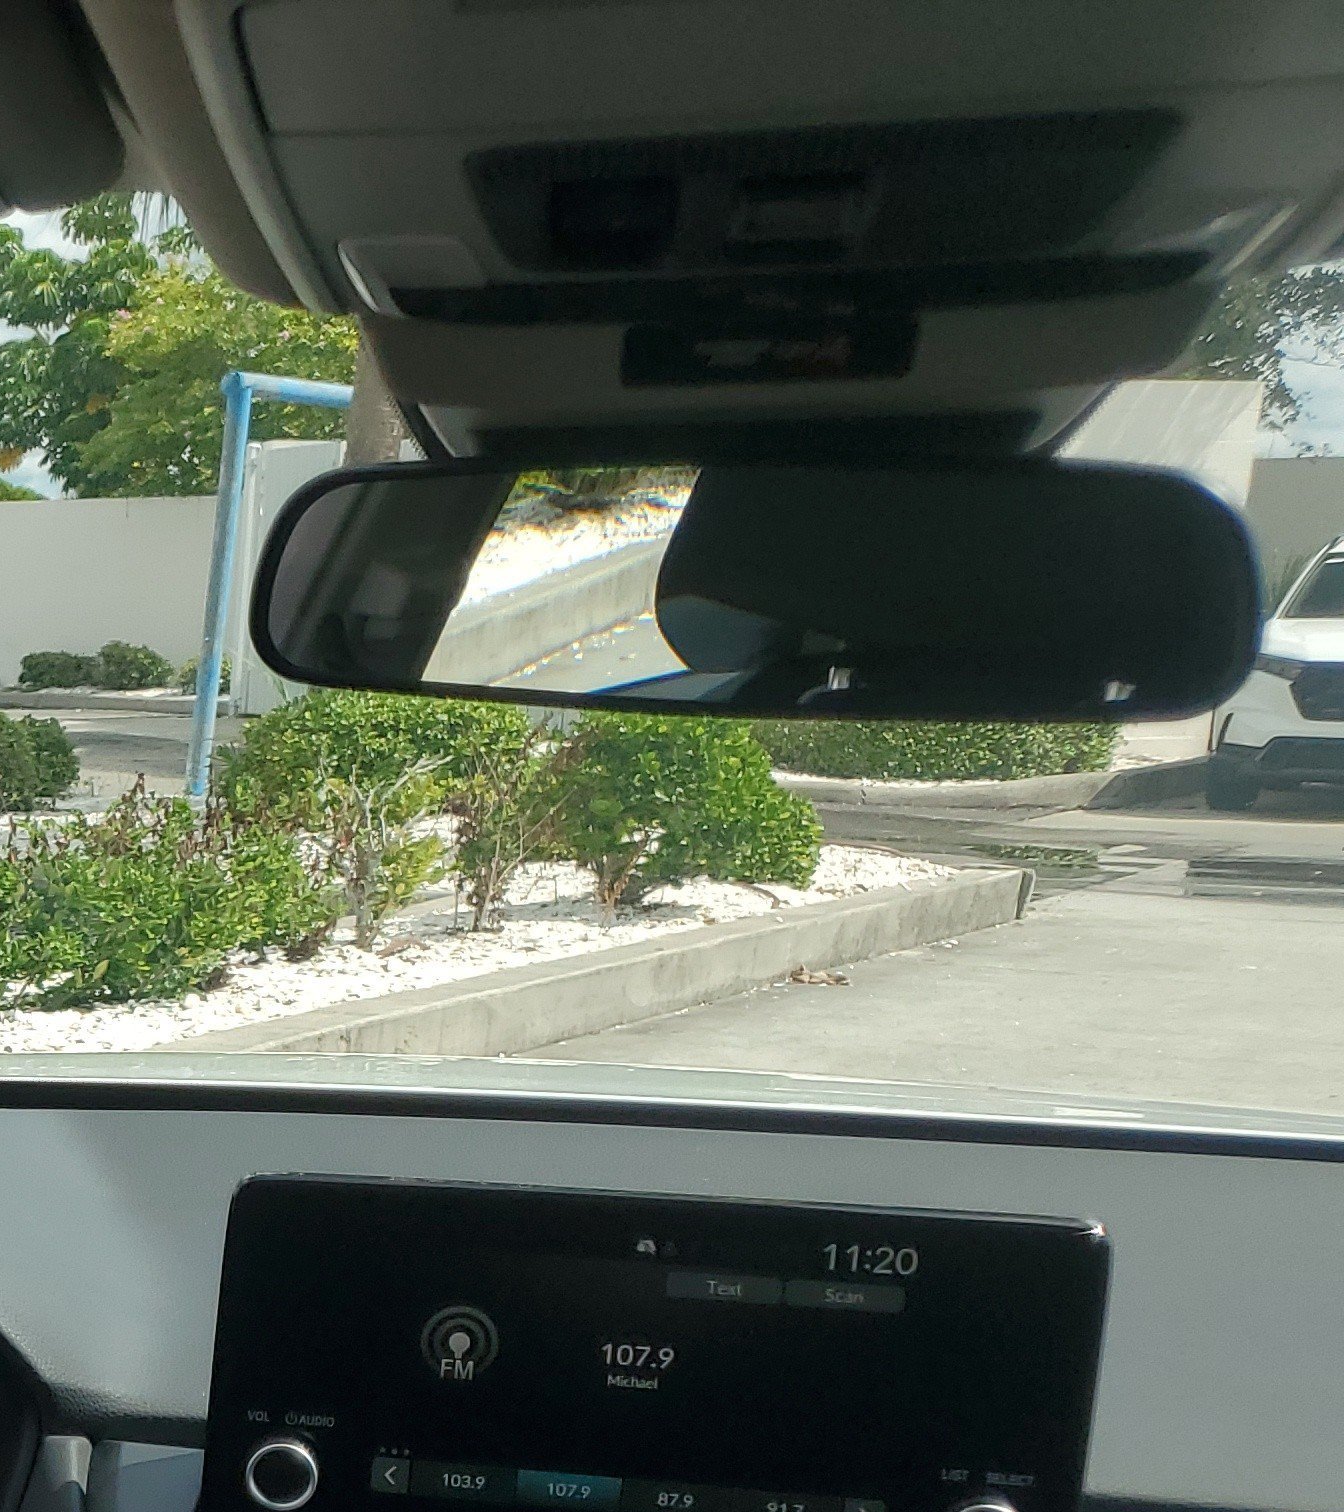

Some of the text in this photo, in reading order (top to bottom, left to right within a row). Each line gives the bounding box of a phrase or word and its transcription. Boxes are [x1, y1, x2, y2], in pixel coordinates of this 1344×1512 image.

[822, 1243, 919, 1276] 11:20
[706, 1280, 742, 1298] Text
[824, 1288, 865, 1304] Scan
[600, 1342, 675, 1370] 107.9
[438, 1358, 475, 1381] FM
[606, 1373, 659, 1391] Michael
[247, 1409, 271, 1423] VOL
[298, 1414, 335, 1428] AUDIO
[442, 1472, 486, 1491] 103.9
[547, 1481, 592, 1500] 107.9
[657, 1491, 694, 1509] 87.9
